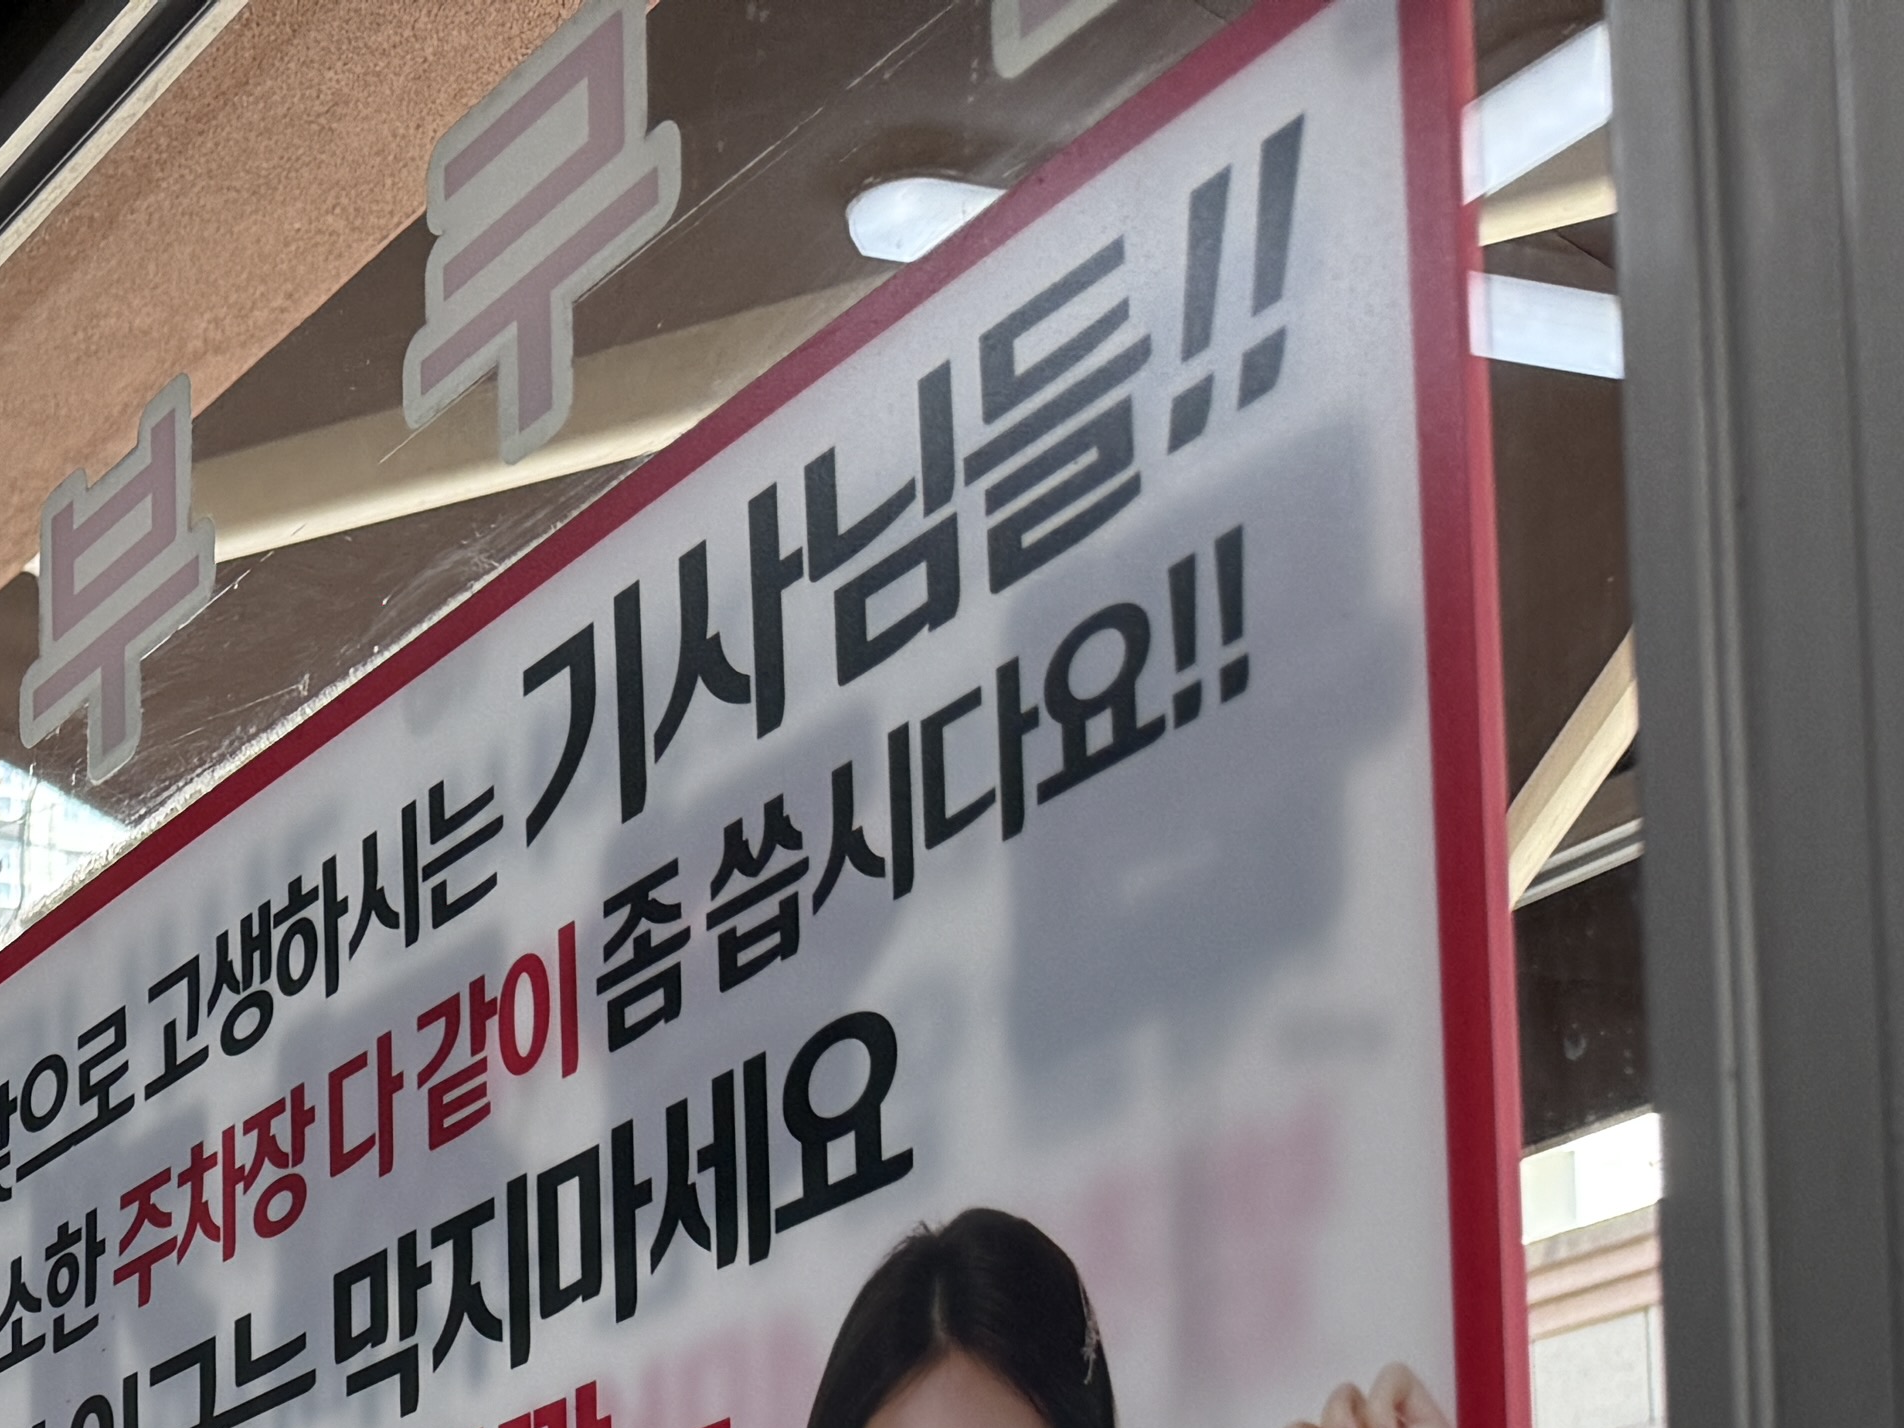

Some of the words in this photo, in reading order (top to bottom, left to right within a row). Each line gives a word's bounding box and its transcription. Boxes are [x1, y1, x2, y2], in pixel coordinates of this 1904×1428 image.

[114, 1082, 316, 1308] 주차장
[596, 858, 692, 1054] 좀
[706, 523, 1251, 994] 씁시다요!!
[144, 775, 504, 1102] 고생하시는
[522, 112, 1304, 849] 기사님들!!
[333, 1009, 914, 1418] 막지마세요
